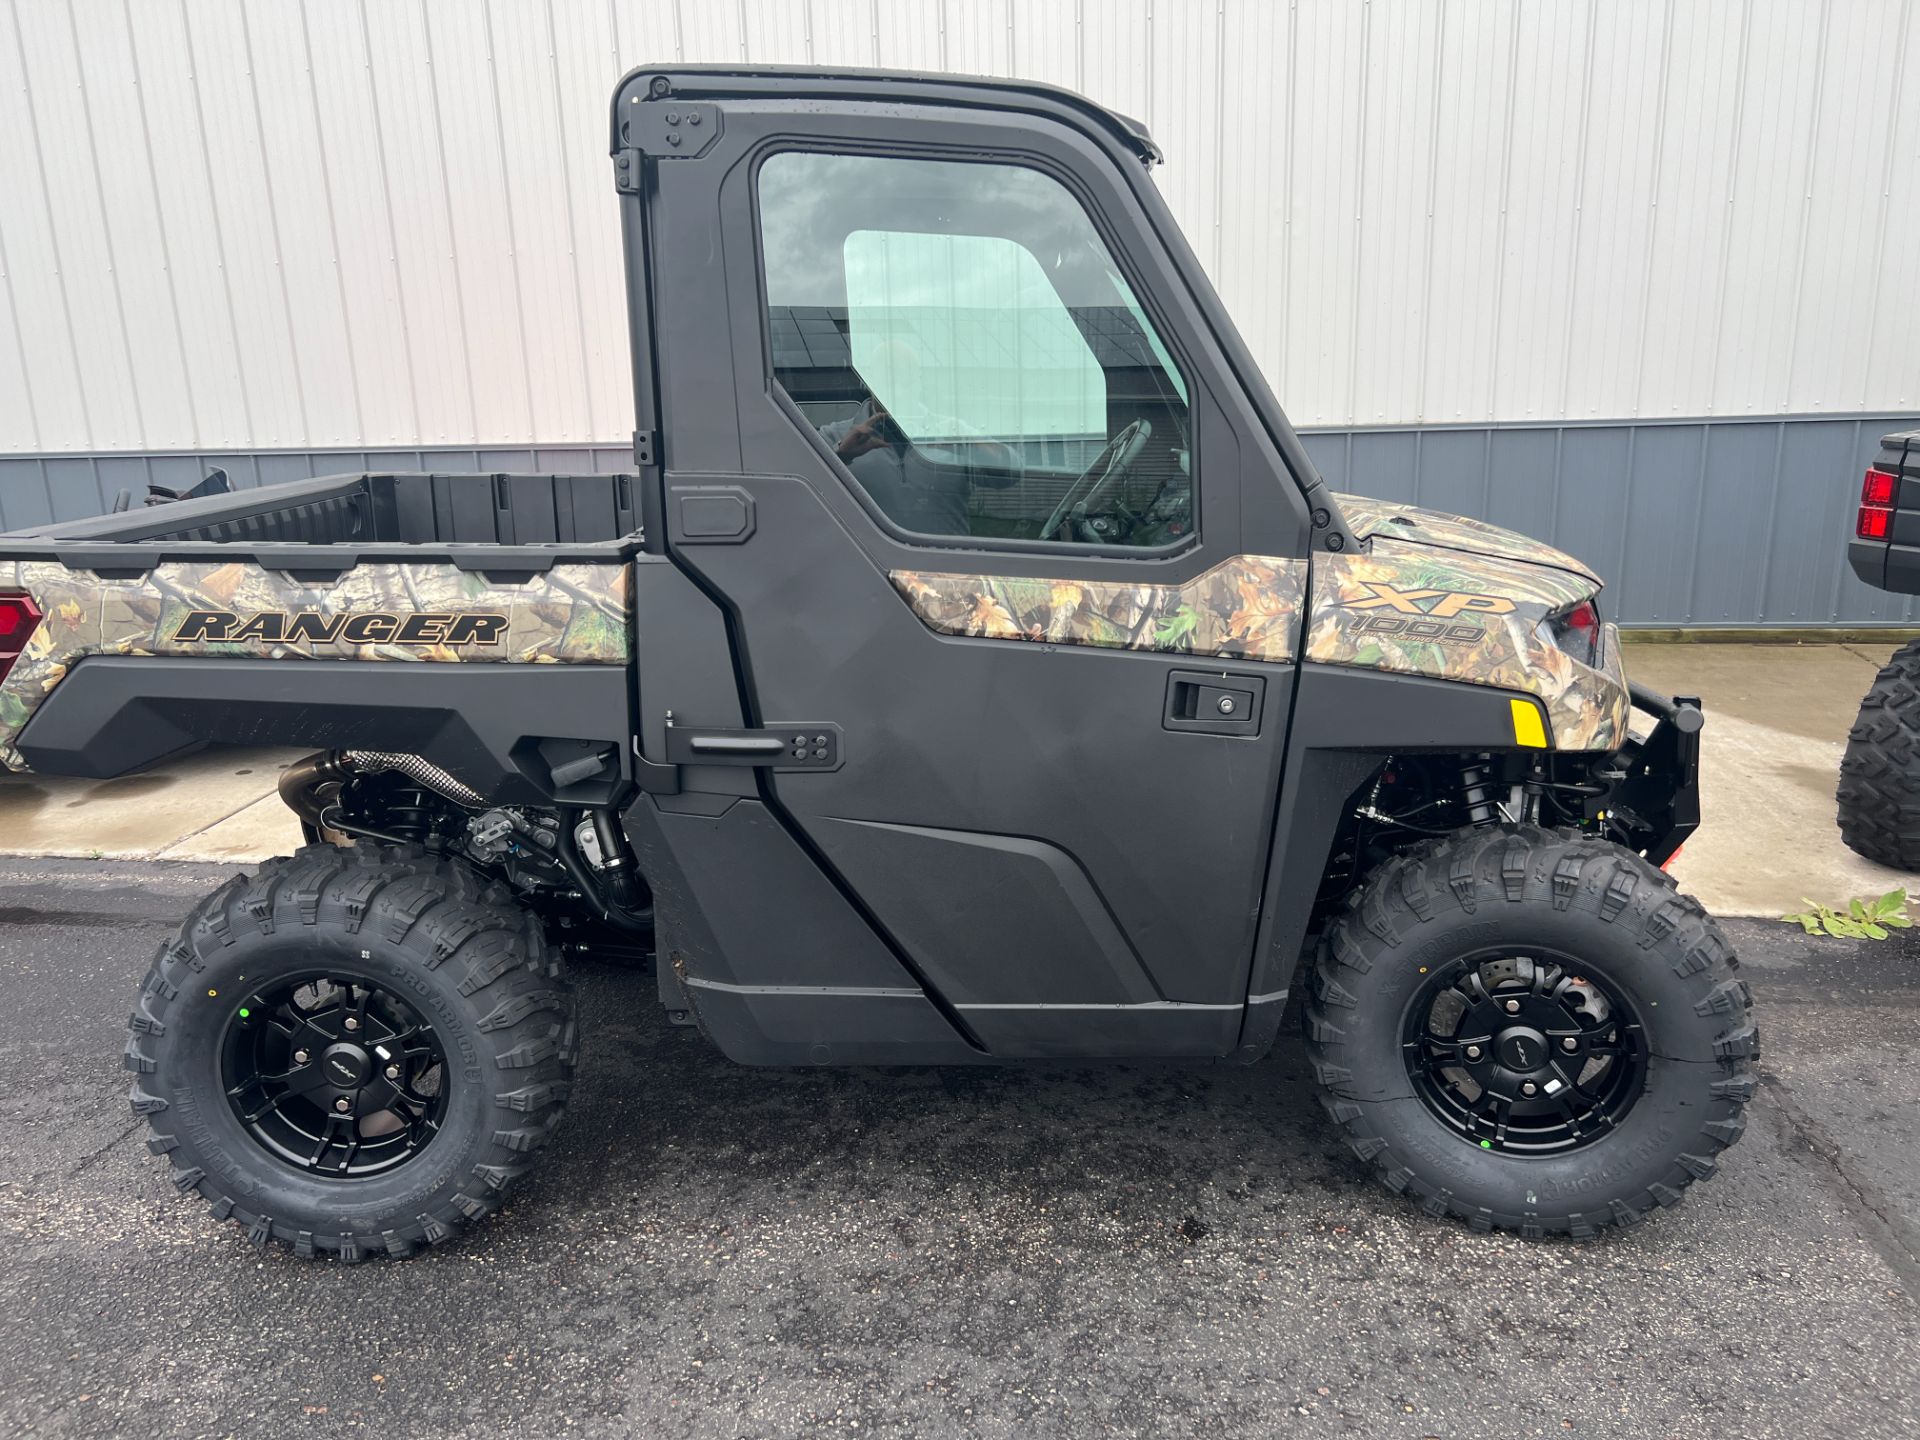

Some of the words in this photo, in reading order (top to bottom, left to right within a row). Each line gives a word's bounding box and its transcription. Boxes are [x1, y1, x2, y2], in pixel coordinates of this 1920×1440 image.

[1322, 581, 1519, 619] XP
[171, 610, 511, 645] RANGER
[1351, 614, 1487, 642] 1000
[390, 965, 432, 998] PRO
[428, 994, 479, 1065] ARMOR
